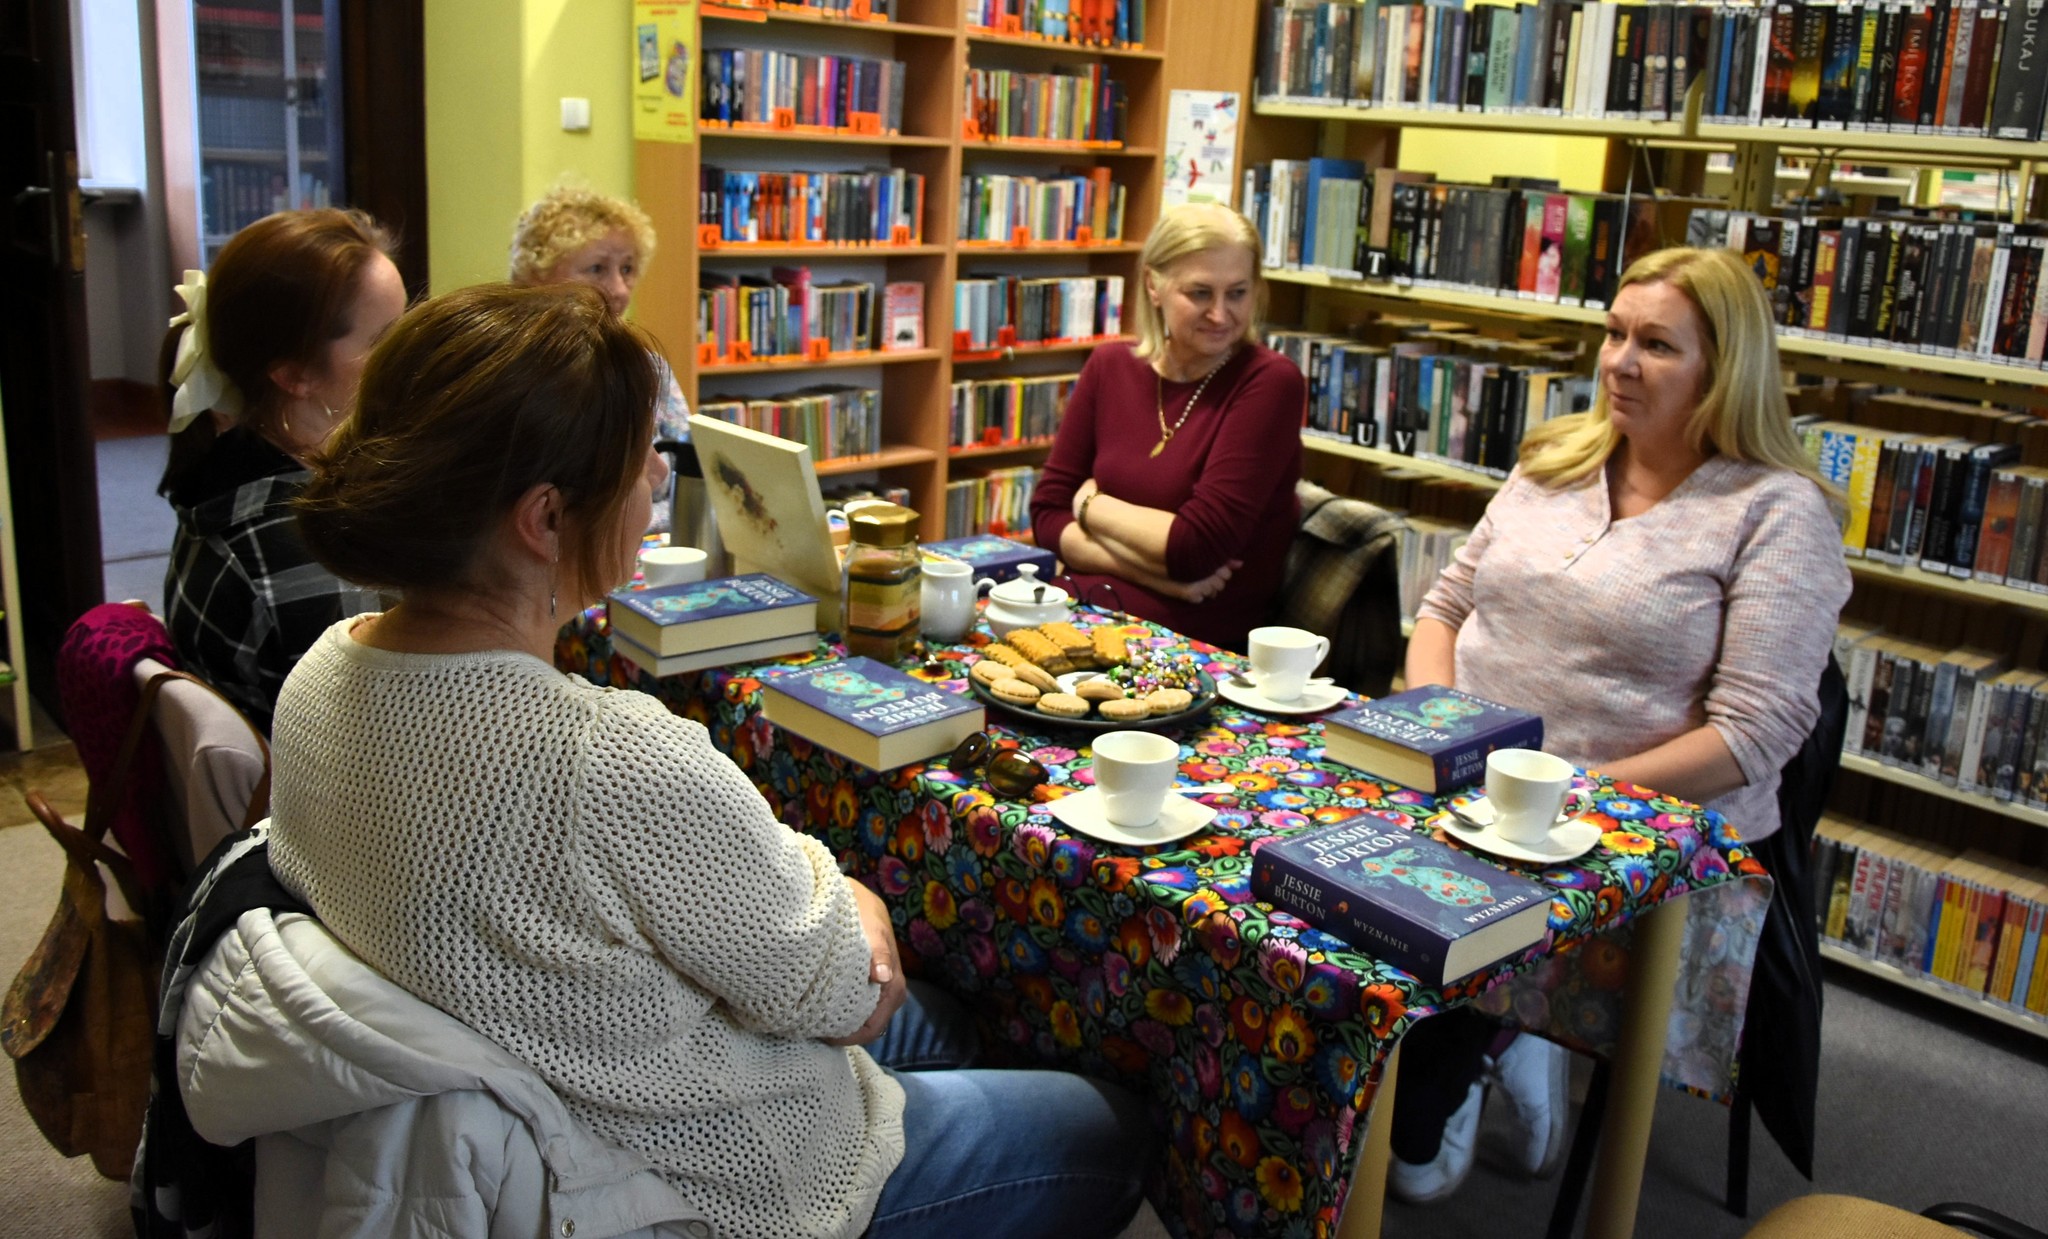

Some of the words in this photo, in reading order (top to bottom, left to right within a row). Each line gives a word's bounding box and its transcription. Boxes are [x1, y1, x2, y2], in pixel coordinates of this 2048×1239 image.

[2018, 6, 2039, 71] DUKAJ
[703, 230, 716, 244] G
[1368, 250, 1386, 276] T
[1357, 422, 1373, 445] U
[1394, 431, 1412, 451] V
[851, 691, 945, 721] BURTON
[879, 700, 950, 725] JESSIE
[1354, 716, 1423, 742] JESSIE
[1356, 708, 1452, 742] BURTON
[1452, 760, 1484, 781] BURTON
[1455, 749, 1480, 766] JESSIE
[1304, 824, 1379, 857] JESSIE
[1313, 830, 1412, 868] BURTON
[1281, 873, 1322, 901] JESSIE
[1274, 885, 1326, 920] BURTON
[1464, 894, 1528, 924] WYZNANIE
[1353, 918, 1409, 953] WYZNANIE
